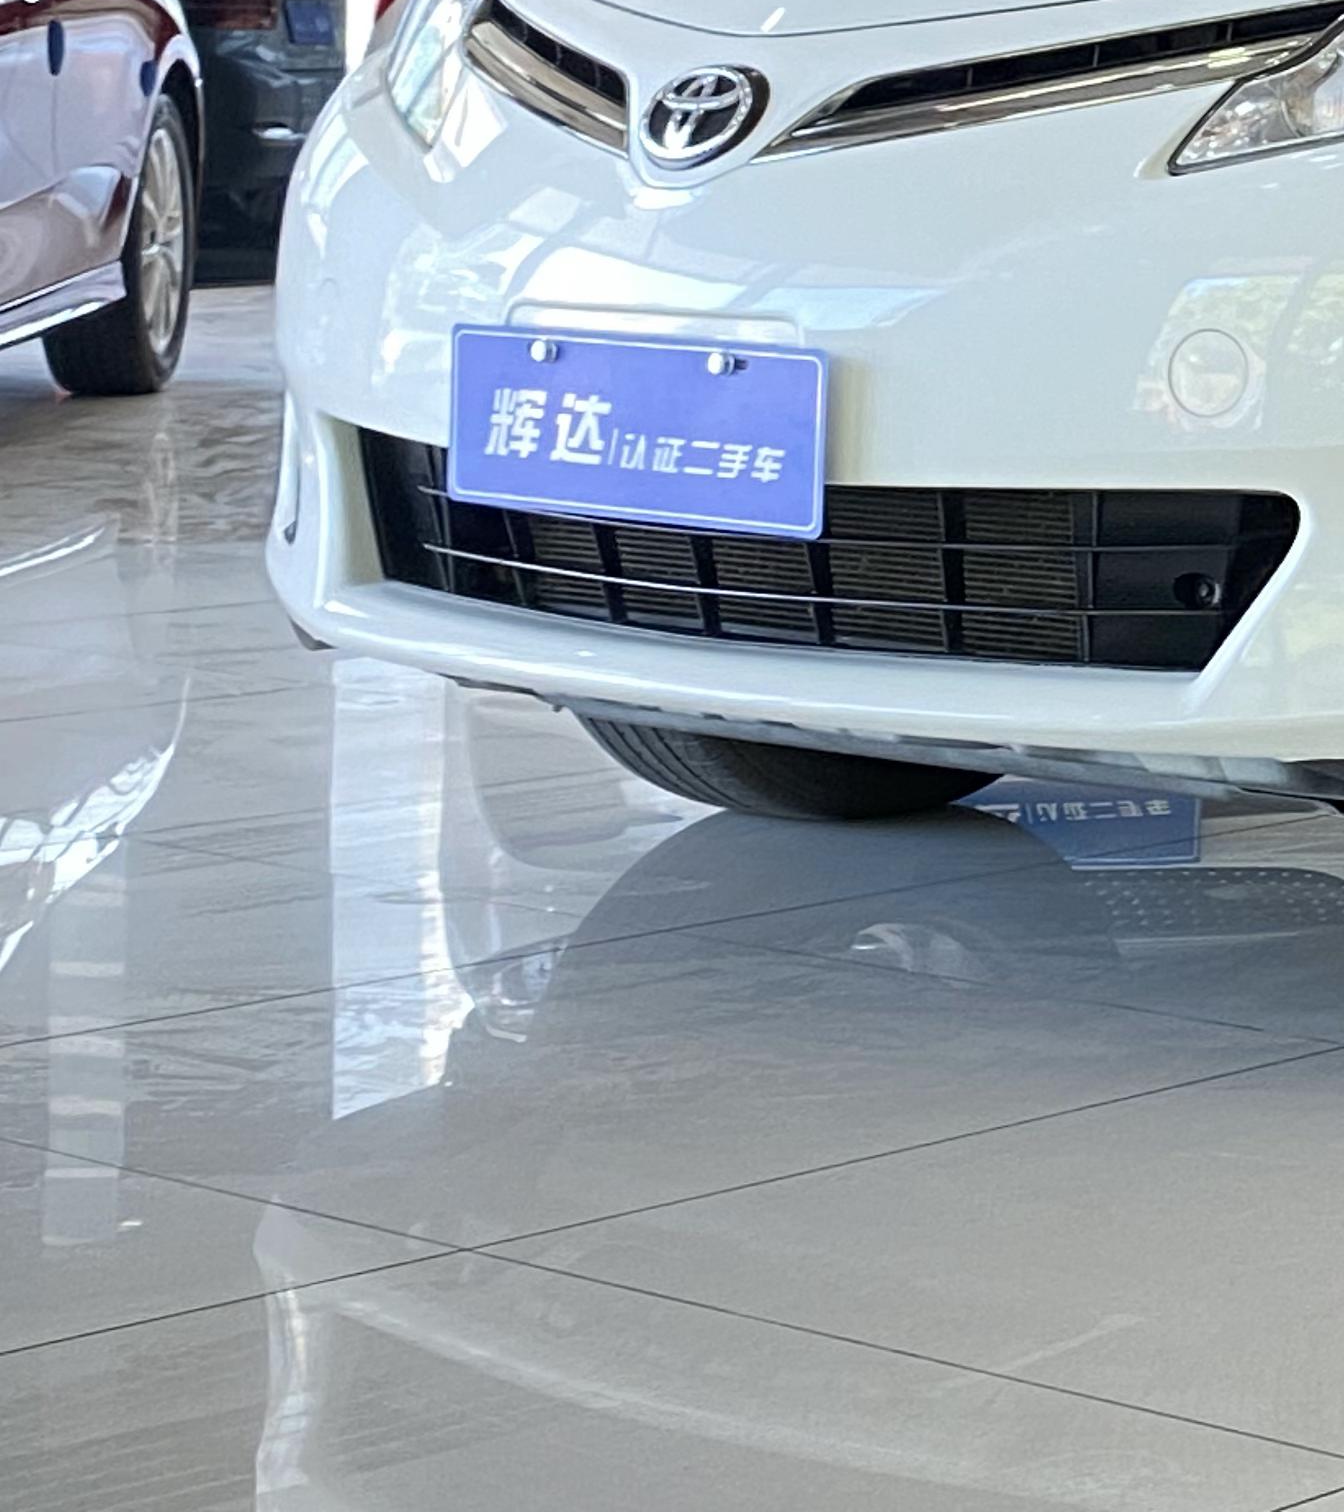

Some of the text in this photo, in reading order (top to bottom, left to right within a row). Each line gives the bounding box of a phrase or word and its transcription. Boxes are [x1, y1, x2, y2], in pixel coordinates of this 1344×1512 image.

[485, 387, 786, 484] 辉达 认证二手车
